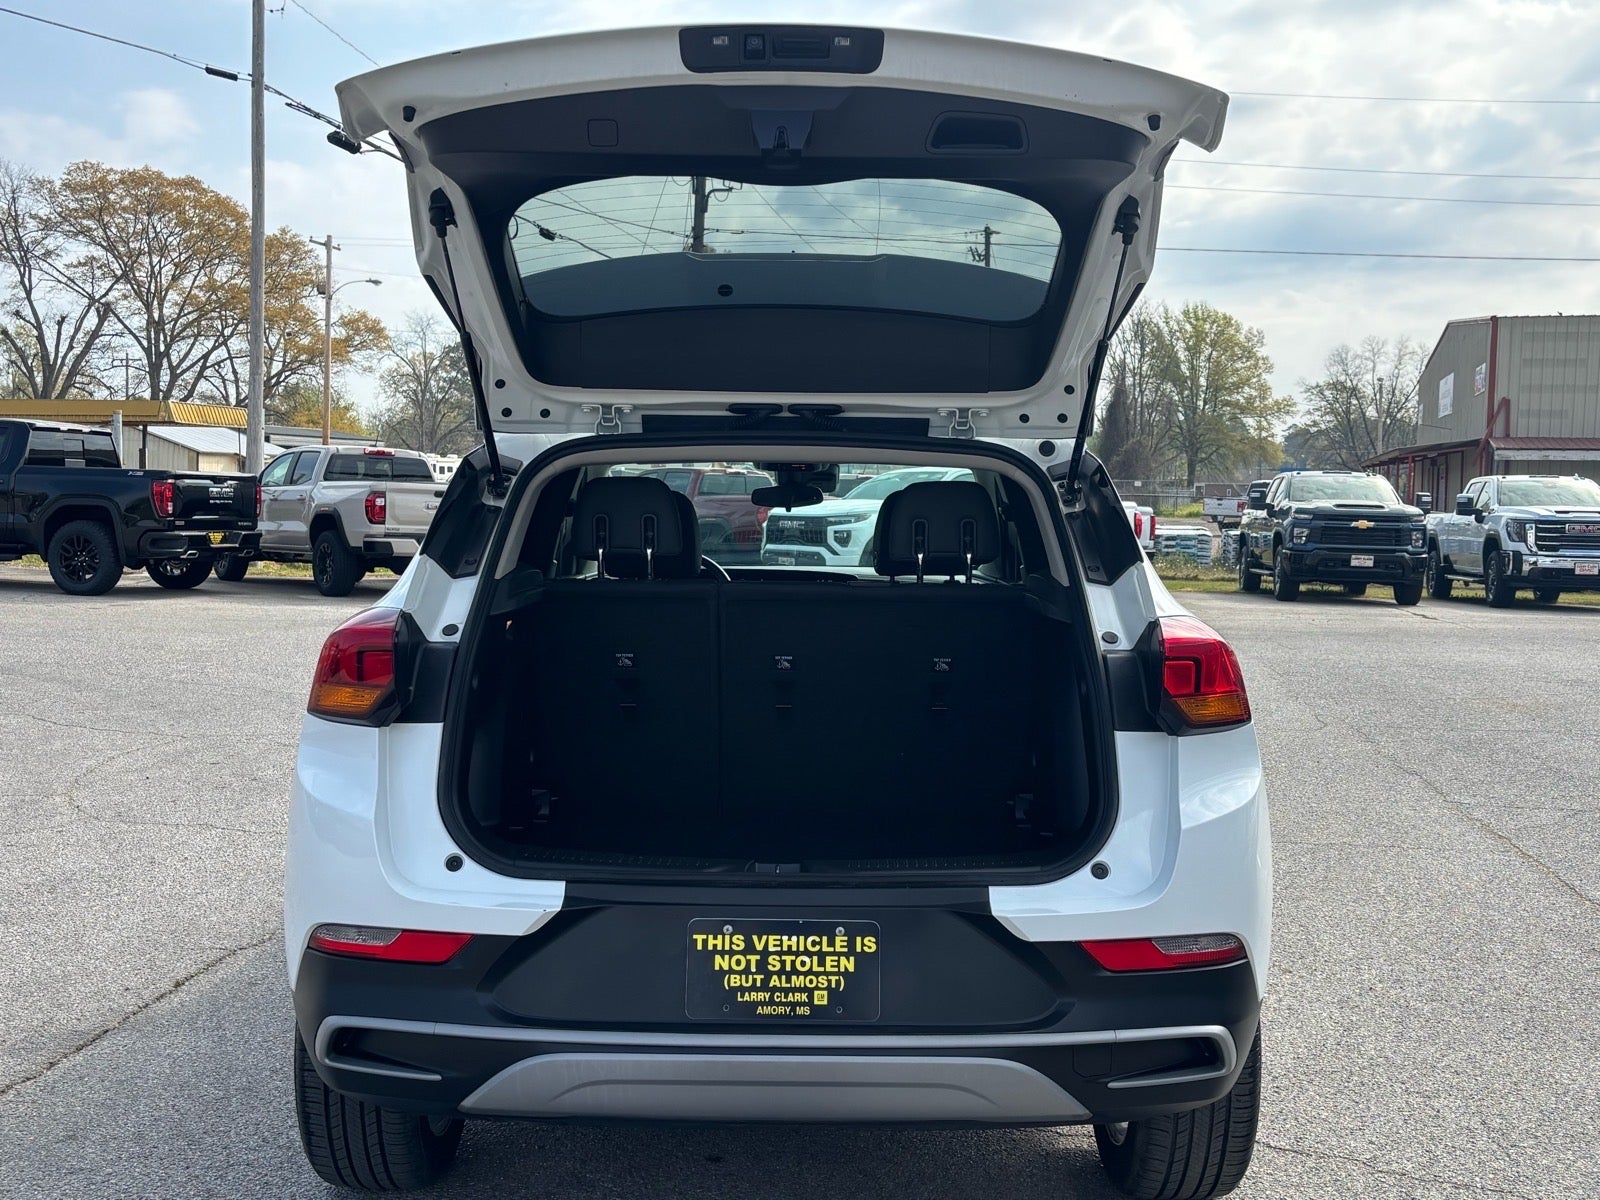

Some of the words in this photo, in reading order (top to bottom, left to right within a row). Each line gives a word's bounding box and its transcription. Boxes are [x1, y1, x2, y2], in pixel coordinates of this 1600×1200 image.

[692, 934, 746, 951] THIS
[752, 935, 849, 952] VEHICLE
[856, 936, 877, 953] IS
[714, 955, 761, 972] NOT
[767, 955, 855, 973] STOLEN
[723, 974, 765, 990] (BUT
[769, 975, 845, 991] ALMOST)
[737, 992, 771, 1002] LARRY
[774, 992, 809, 1002] CLARK
[756, 1005, 794, 1016] AMORY,
[796, 1006, 811, 1016] MS
